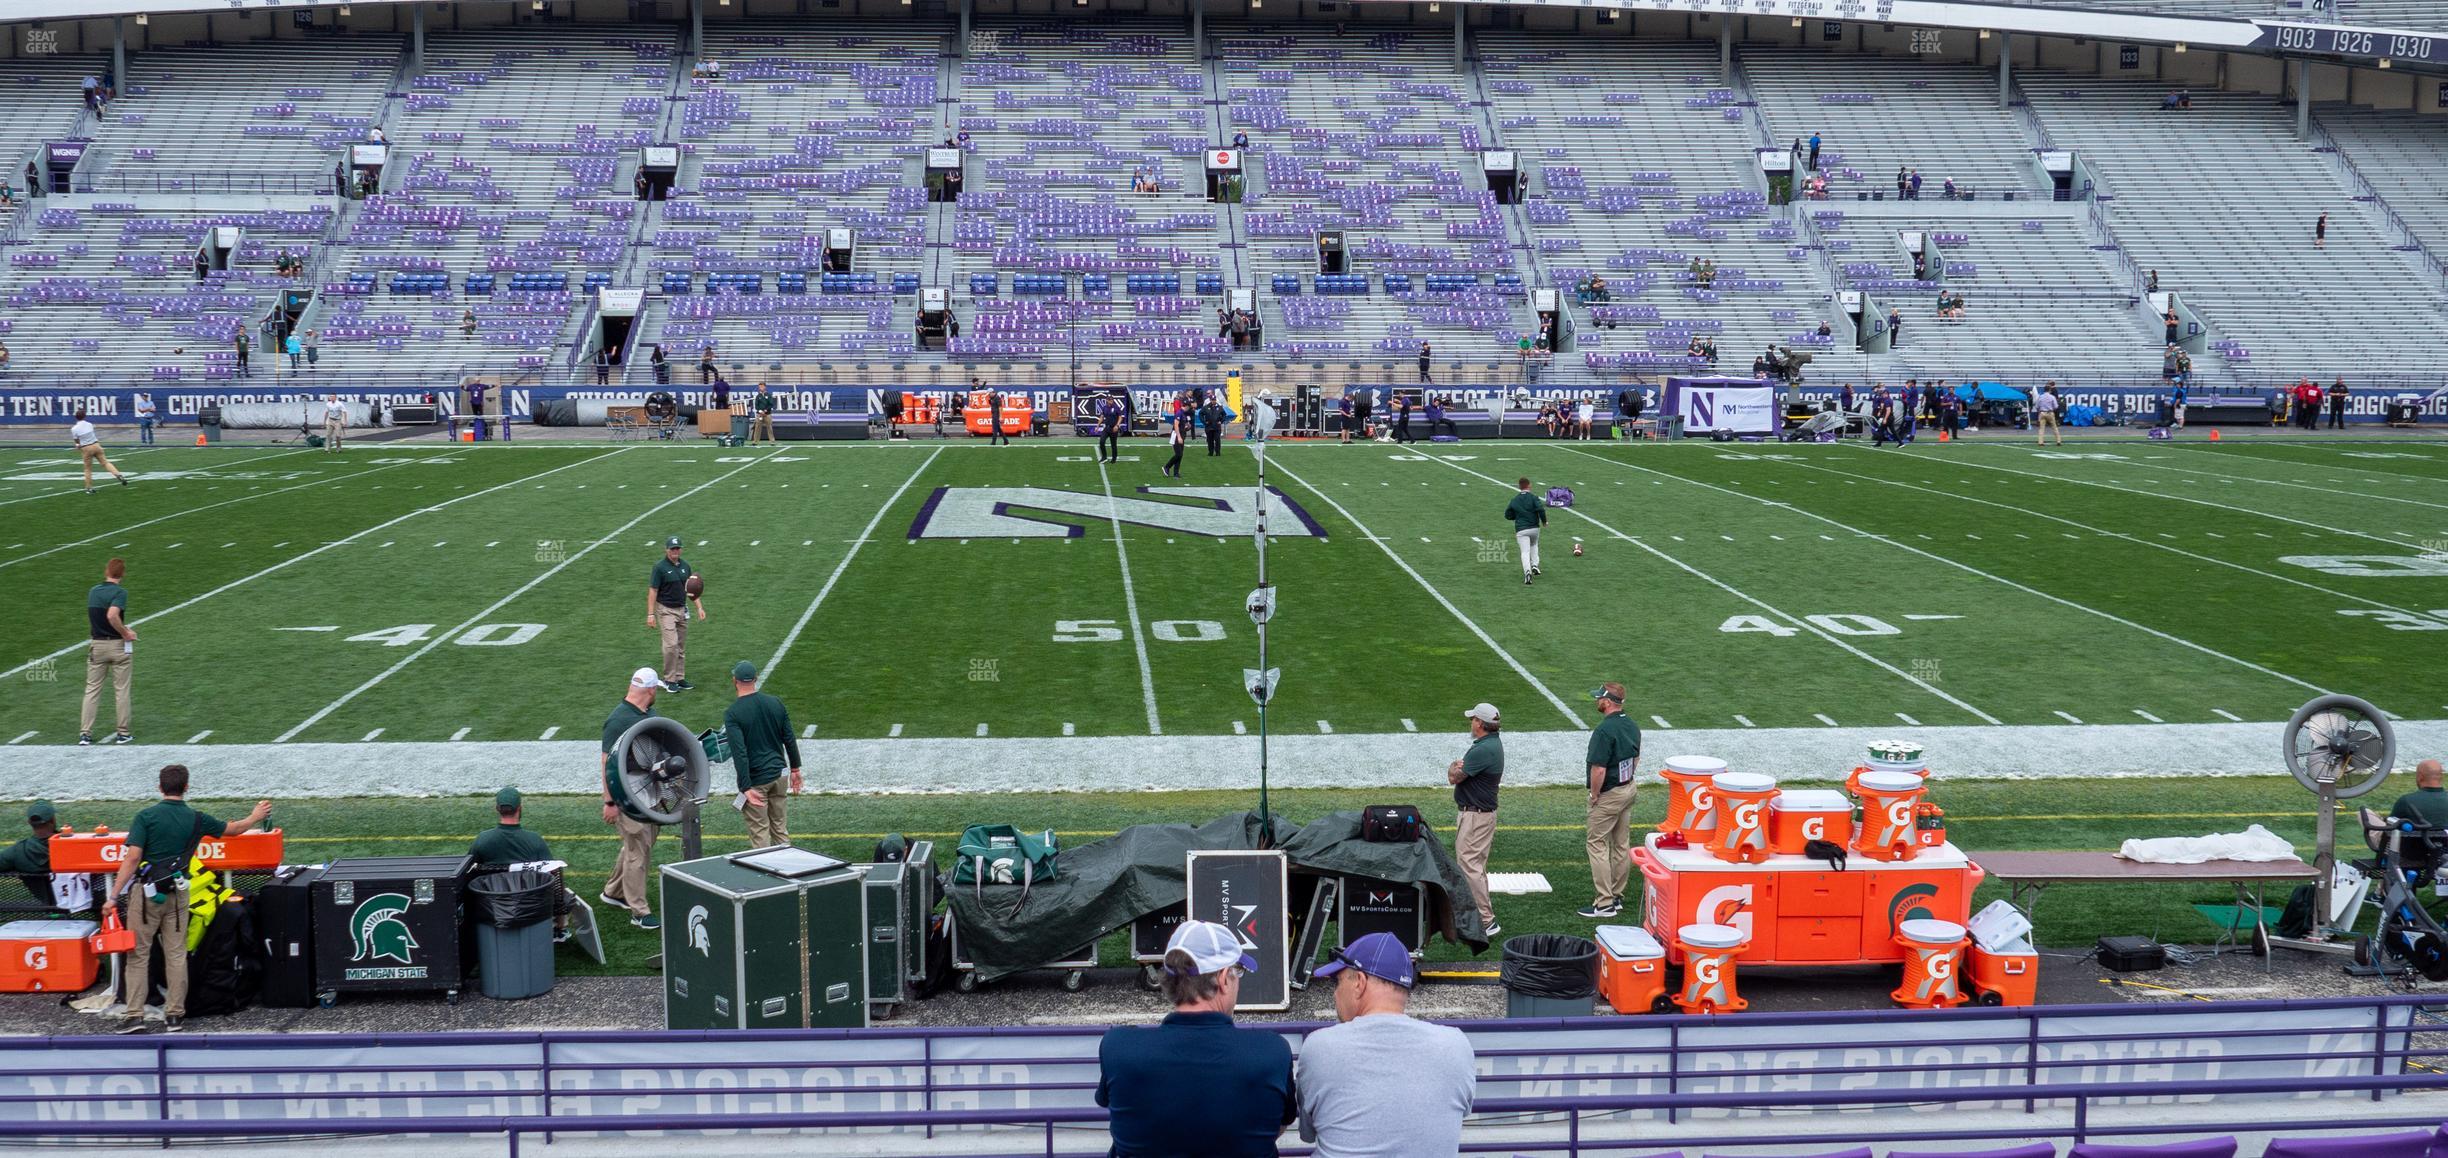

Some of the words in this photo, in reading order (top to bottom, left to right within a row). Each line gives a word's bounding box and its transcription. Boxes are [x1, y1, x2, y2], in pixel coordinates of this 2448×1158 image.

[1788, 1, 1823, 10] FITZGERALD
[1835, 4, 1866, 13] ANDERSON
[1876, 6, 1892, 14] MARK
[1825, 23, 1841, 34] 132
[2274, 27, 2316, 50] 1903
[2332, 30, 2373, 54] 1926
[2389, 35, 2431, 59] 1930
[2120, 52, 2138, 63] 133
[1764, 159, 1786, 168] Hilton
[10, 396, 53, 416] TEN
[58, 396, 118, 416] TEAM
[438, 391, 455, 416] N
[511, 389, 530, 416] N
[772, 391, 831, 411] TEAM
[867, 389, 885, 415] N
[1690, 391, 1714, 427] N
[2123, 394, 2155, 413] BIG
[2403, 408, 2411, 419] N
[905, 486, 1328, 538] N
[345, 624, 549, 647] 40
[1052, 619, 1227, 642] 50
[1719, 613, 1901, 637] 40
[1692, 786, 1714, 811] G
[1735, 804, 1759, 829] G
[1889, 801, 1911, 826] G
[1802, 817, 1824, 840] G
[1921, 832, 1932, 844] G
[101, 842, 226, 862] GADE
[1163, 916, 1178, 924] MV
[1696, 884, 1753, 944] G
[25, 946, 48, 970] G
[1928, 953, 1951, 979] G
[345, 966, 396, 981] MICHIGAN
[397, 966, 428, 979] STATE
[1696, 958, 1719, 984] G
